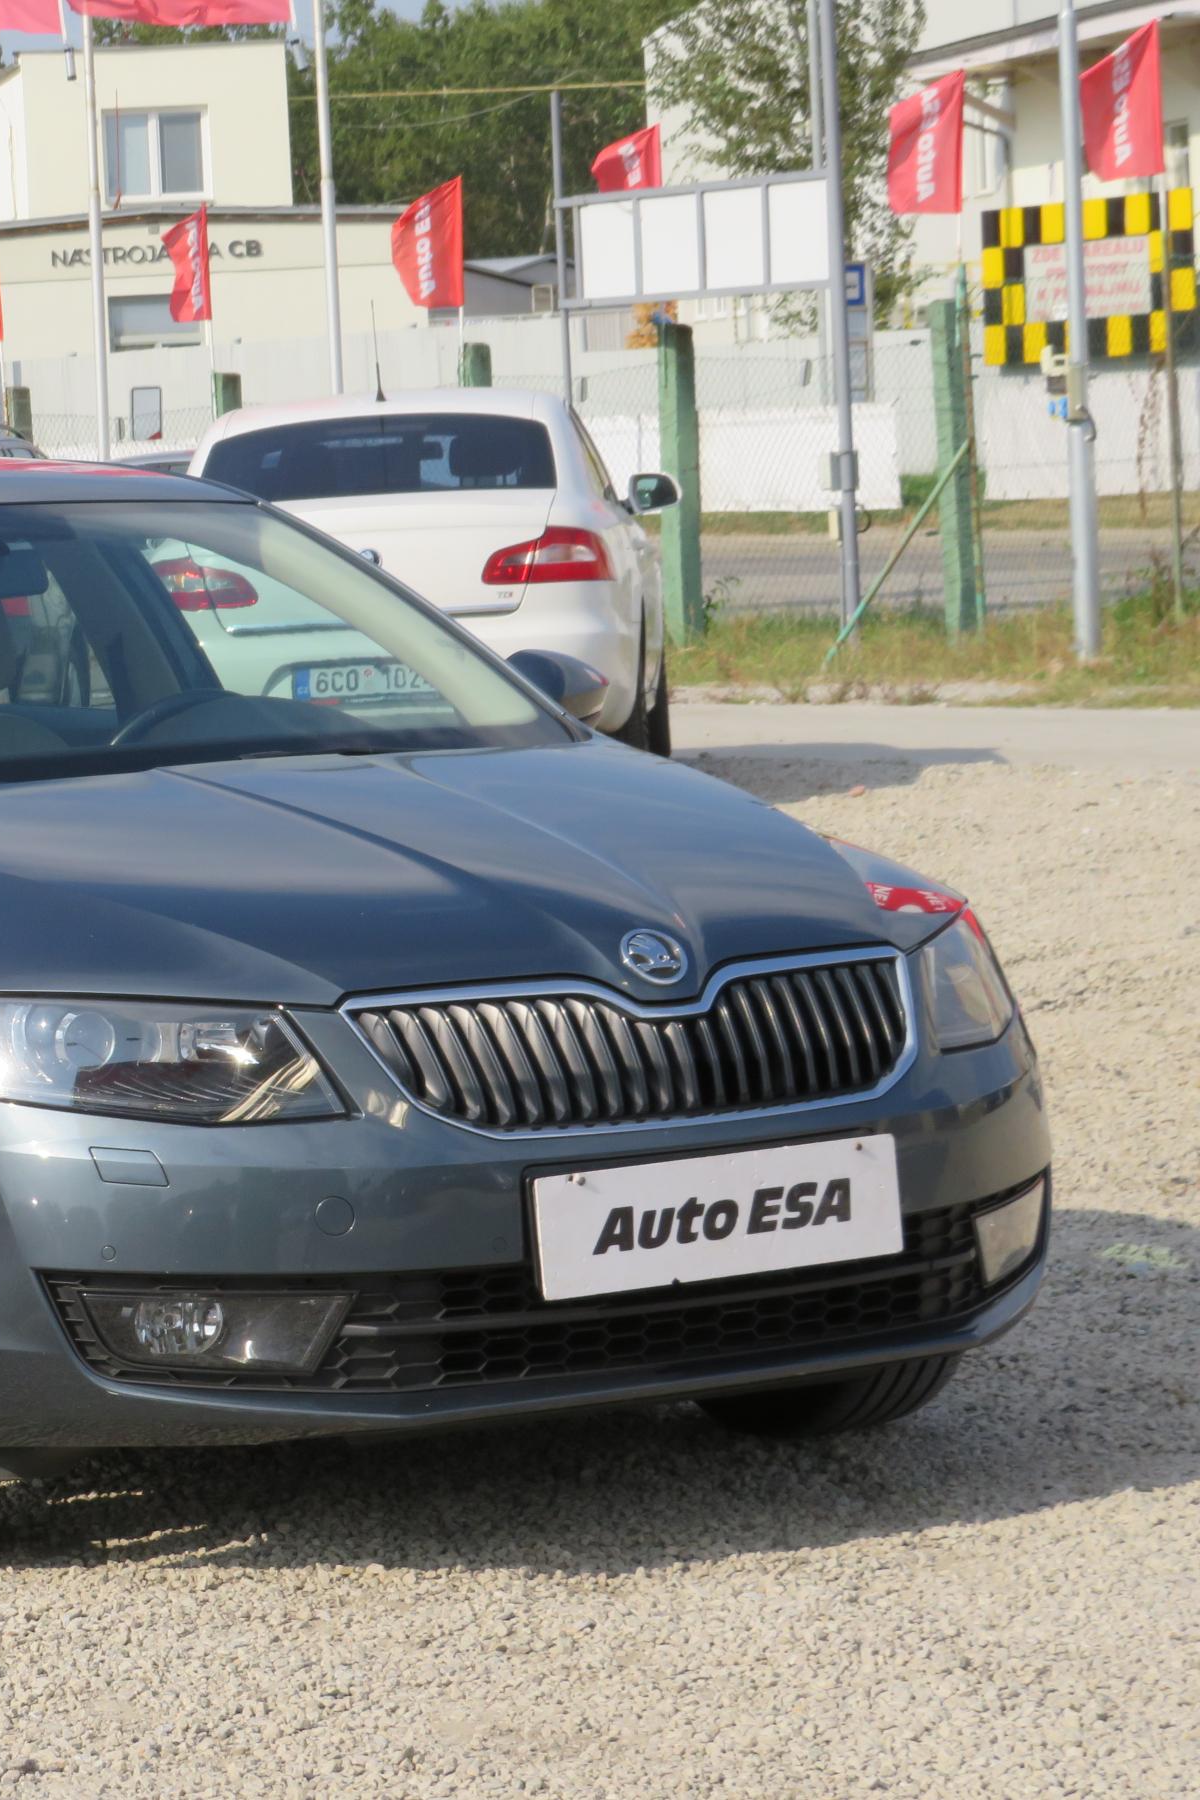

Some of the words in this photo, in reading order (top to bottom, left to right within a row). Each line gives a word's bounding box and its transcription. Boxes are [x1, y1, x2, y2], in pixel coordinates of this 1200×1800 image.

[228, 240, 263, 258] CB
[592, 1195, 739, 1256] Auto
[746, 1177, 852, 1236] ESA
